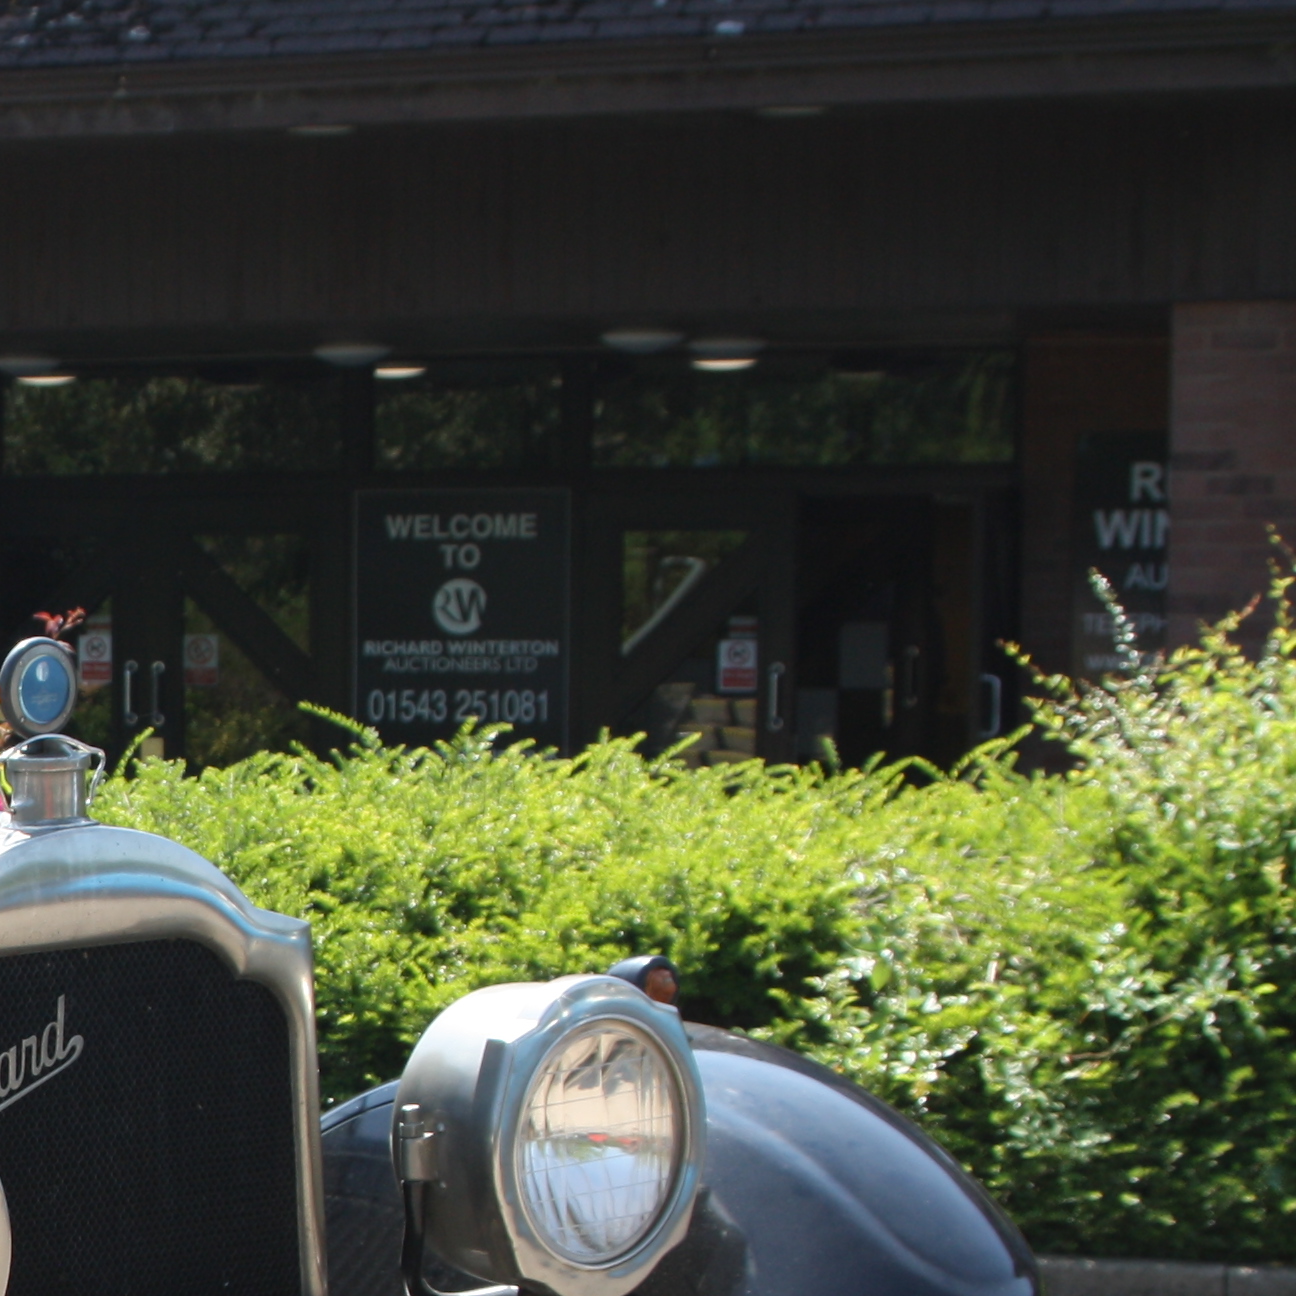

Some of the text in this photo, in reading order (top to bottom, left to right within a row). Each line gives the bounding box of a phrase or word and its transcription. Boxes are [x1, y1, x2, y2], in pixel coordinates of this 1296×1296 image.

[385, 513, 539, 539] WELCOME
[440, 543, 482, 569] TO
[363, 640, 560, 656] RICHARD WINTERTON
[383, 656, 539, 672] AUCTIONEERS LTD
[368, 689, 550, 723] 01543 251081
